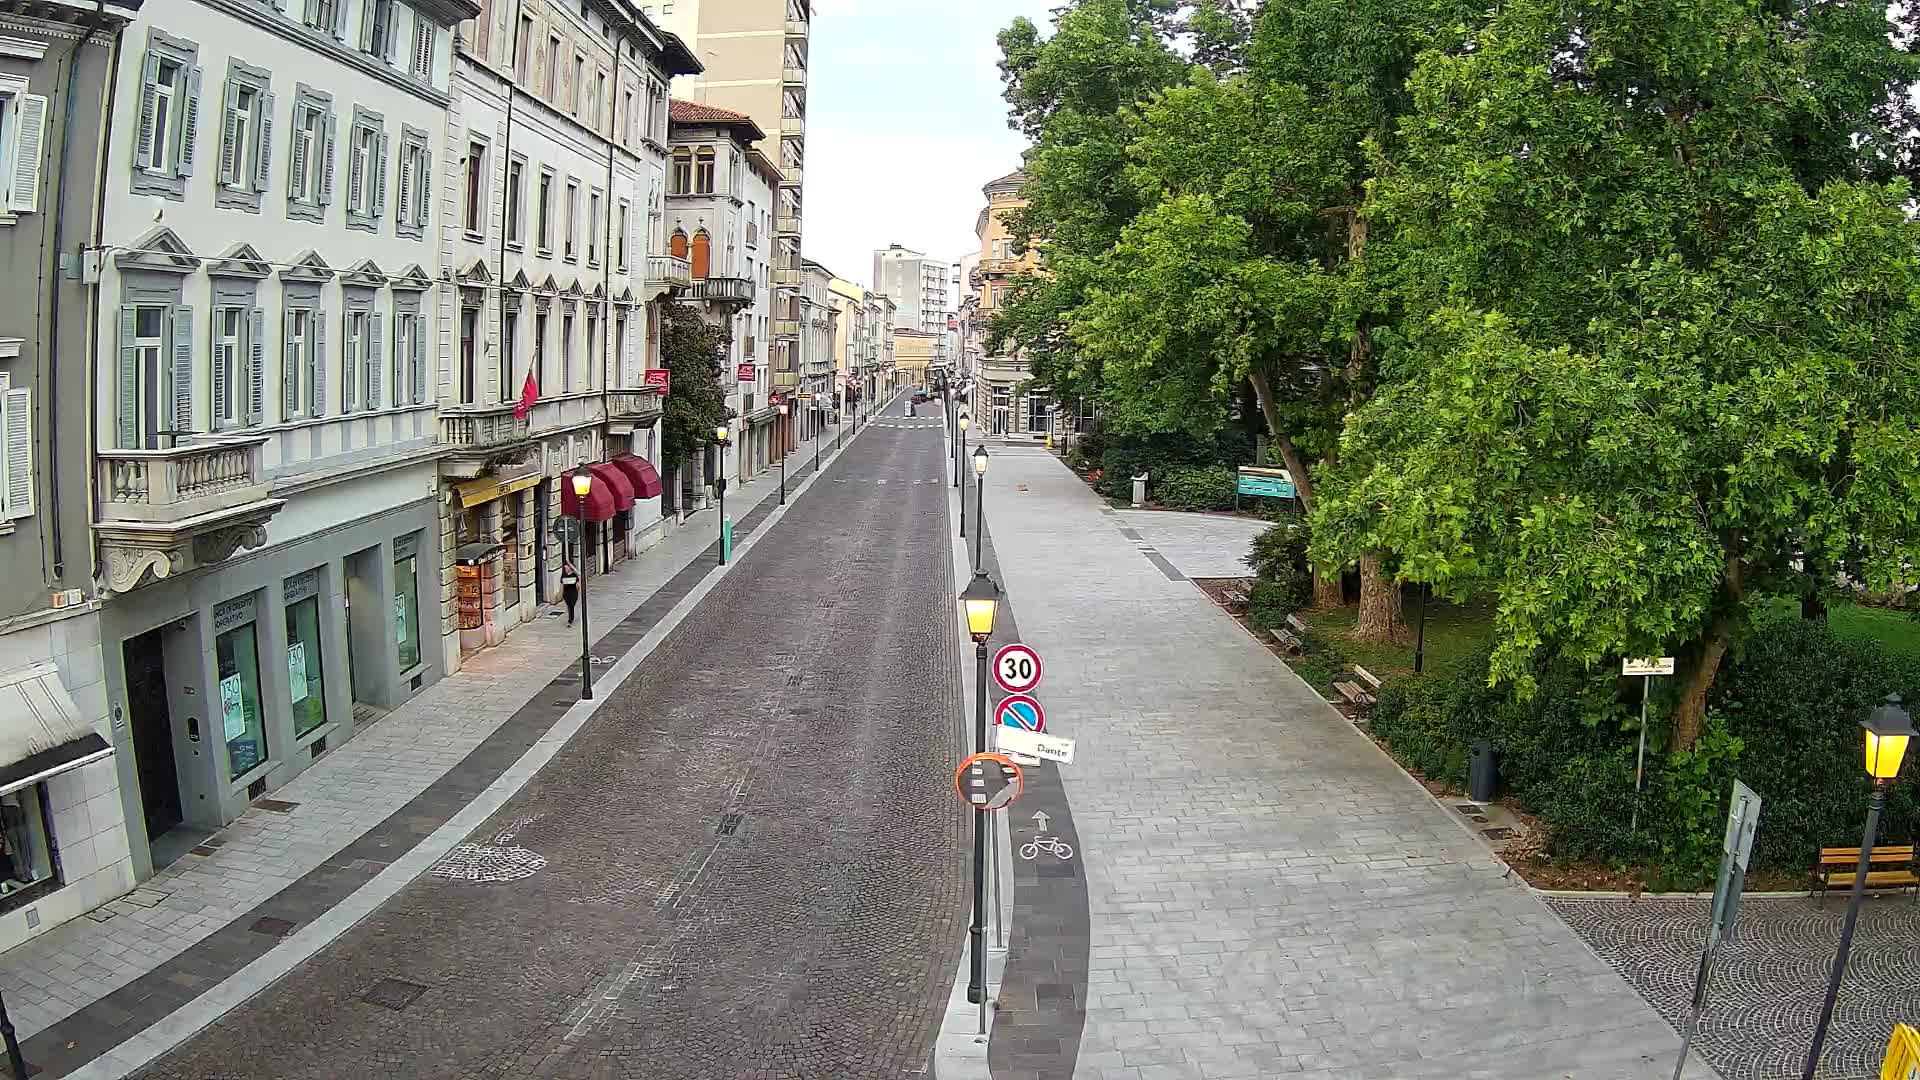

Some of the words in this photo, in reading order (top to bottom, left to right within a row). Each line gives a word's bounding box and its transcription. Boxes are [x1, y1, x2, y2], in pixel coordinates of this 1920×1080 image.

[215, 610, 243, 628] OPERATIVO
[1005, 658, 1031, 679] 30
[1037, 743, 1067, 757] Dante
